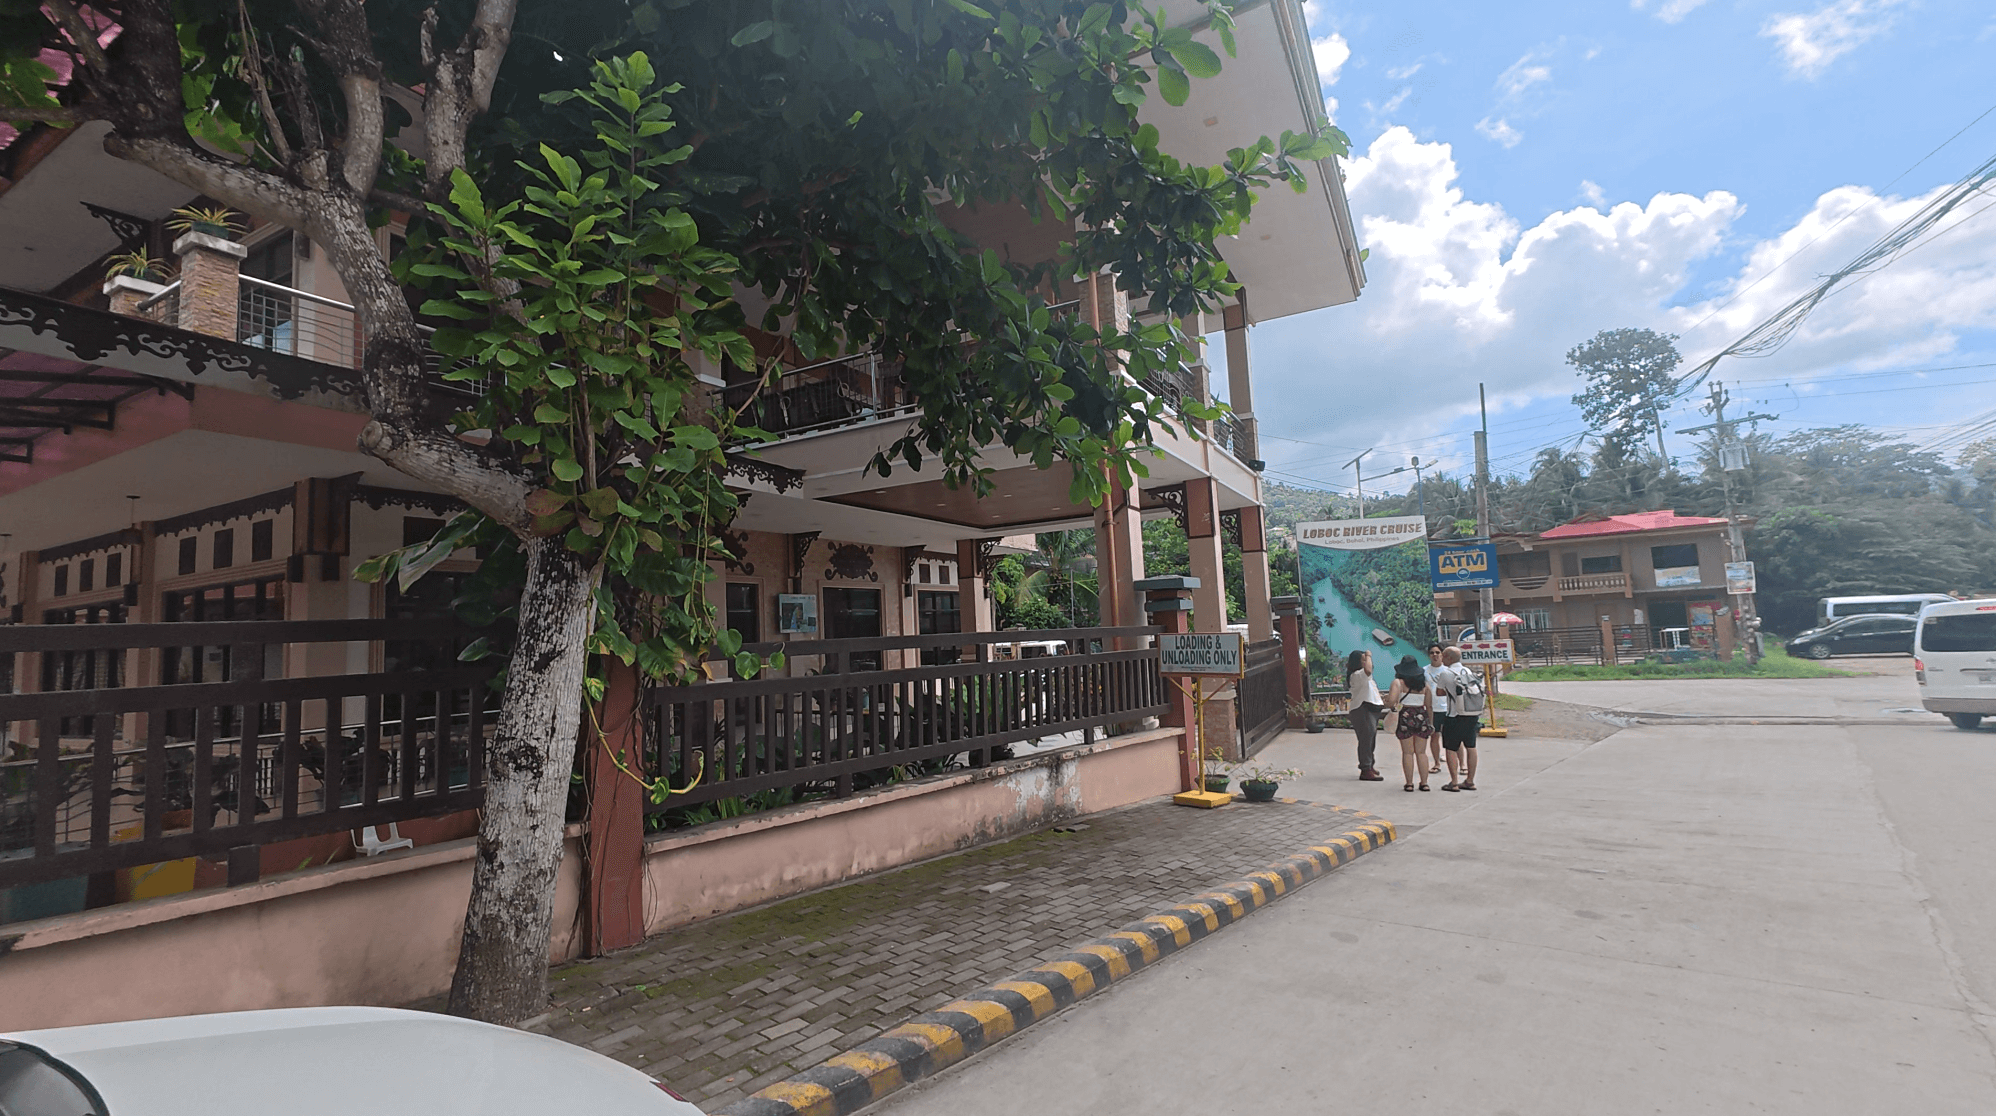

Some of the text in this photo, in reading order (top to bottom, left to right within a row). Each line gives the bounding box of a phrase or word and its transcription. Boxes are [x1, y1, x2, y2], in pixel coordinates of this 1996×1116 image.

[1303, 522, 1422, 539] LOBOC RIVER CRUISE
[1441, 553, 1485, 568] ATM
[1175, 635, 1222, 650] LOADING &
[1161, 650, 1237, 665] UNLOADING ONLY
[1461, 650, 1509, 660] ENTRANCE
